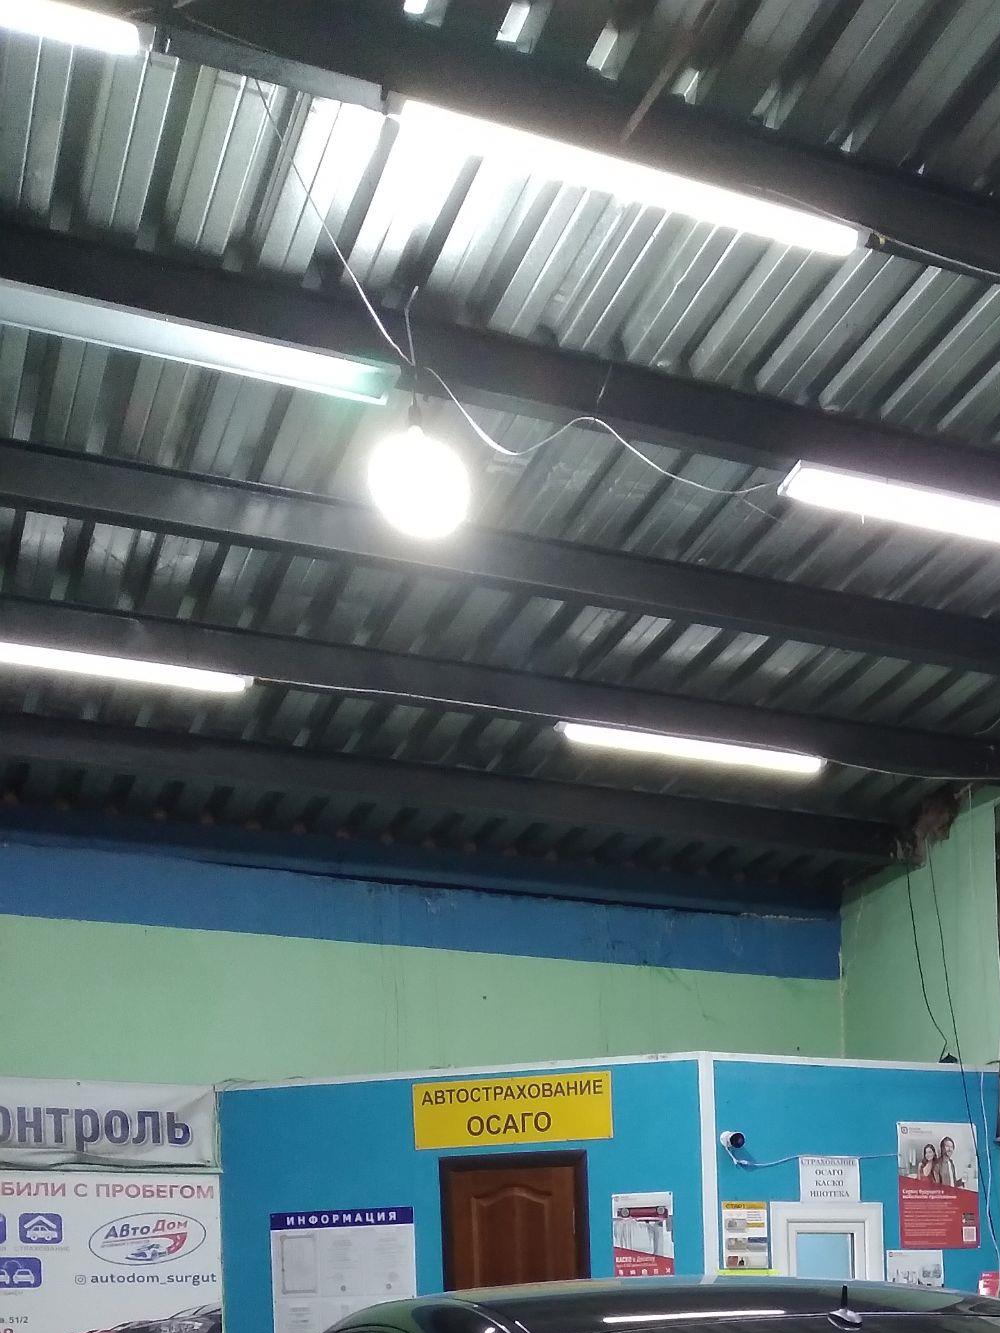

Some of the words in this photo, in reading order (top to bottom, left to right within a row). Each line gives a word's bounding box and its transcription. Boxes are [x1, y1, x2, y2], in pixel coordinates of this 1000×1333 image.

[421, 1079, 604, 1106] АВТОСТРАХОВАНИЕ
[466, 1111, 552, 1137] ОСАГО
[815, 1169, 843, 1177] ОСАГО
[73, 1183, 88, 1198] С
[95, 1183, 214, 1200] ПРОБЕГОМ
[815, 1180, 844, 1188] КАСКО
[809, 1190, 850, 1198] ИПОТЕКА
[286, 1211, 397, 1226] ИНФОРМАЦИЯ
[90, 1272, 218, 1287] autodom_surgut
[9, 1315, 29, 1325] 51/2
